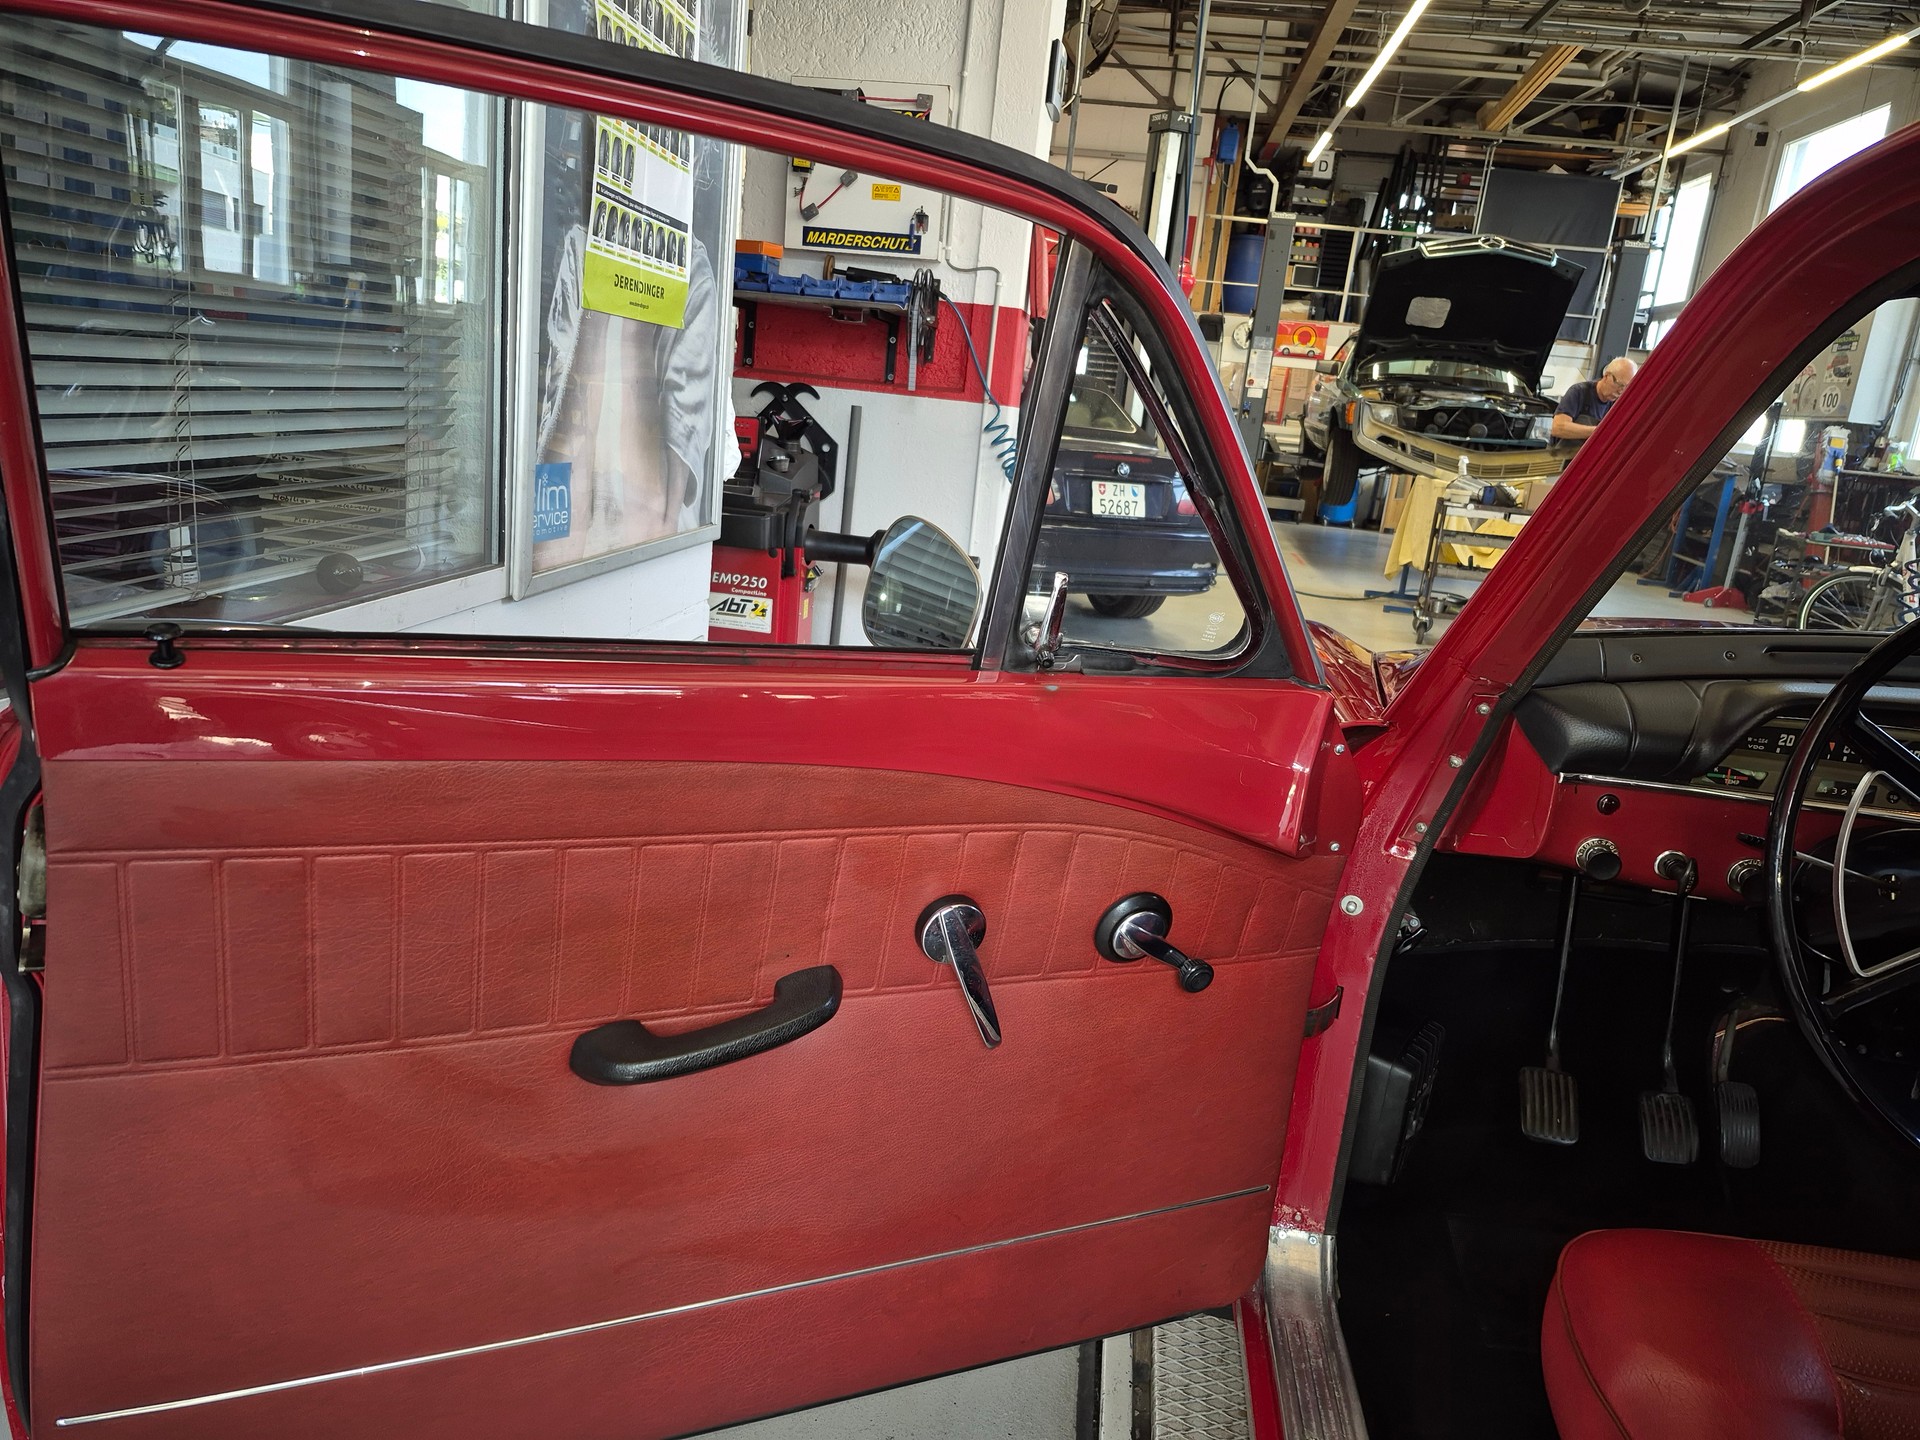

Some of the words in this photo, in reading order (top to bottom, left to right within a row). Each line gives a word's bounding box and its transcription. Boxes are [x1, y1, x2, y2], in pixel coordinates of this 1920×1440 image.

[614, 273, 665, 299] DERENDINGER
[1822, 392, 1839, 409] 100
[536, 473, 569, 512] lim
[1112, 484, 1125, 496] ZH
[1099, 498, 1139, 517] 52687
[533, 510, 569, 529] ervice
[712, 572, 767, 589] EM9250
[731, 587, 767, 597] CompactLine
[1778, 734, 1795, 746] 20
